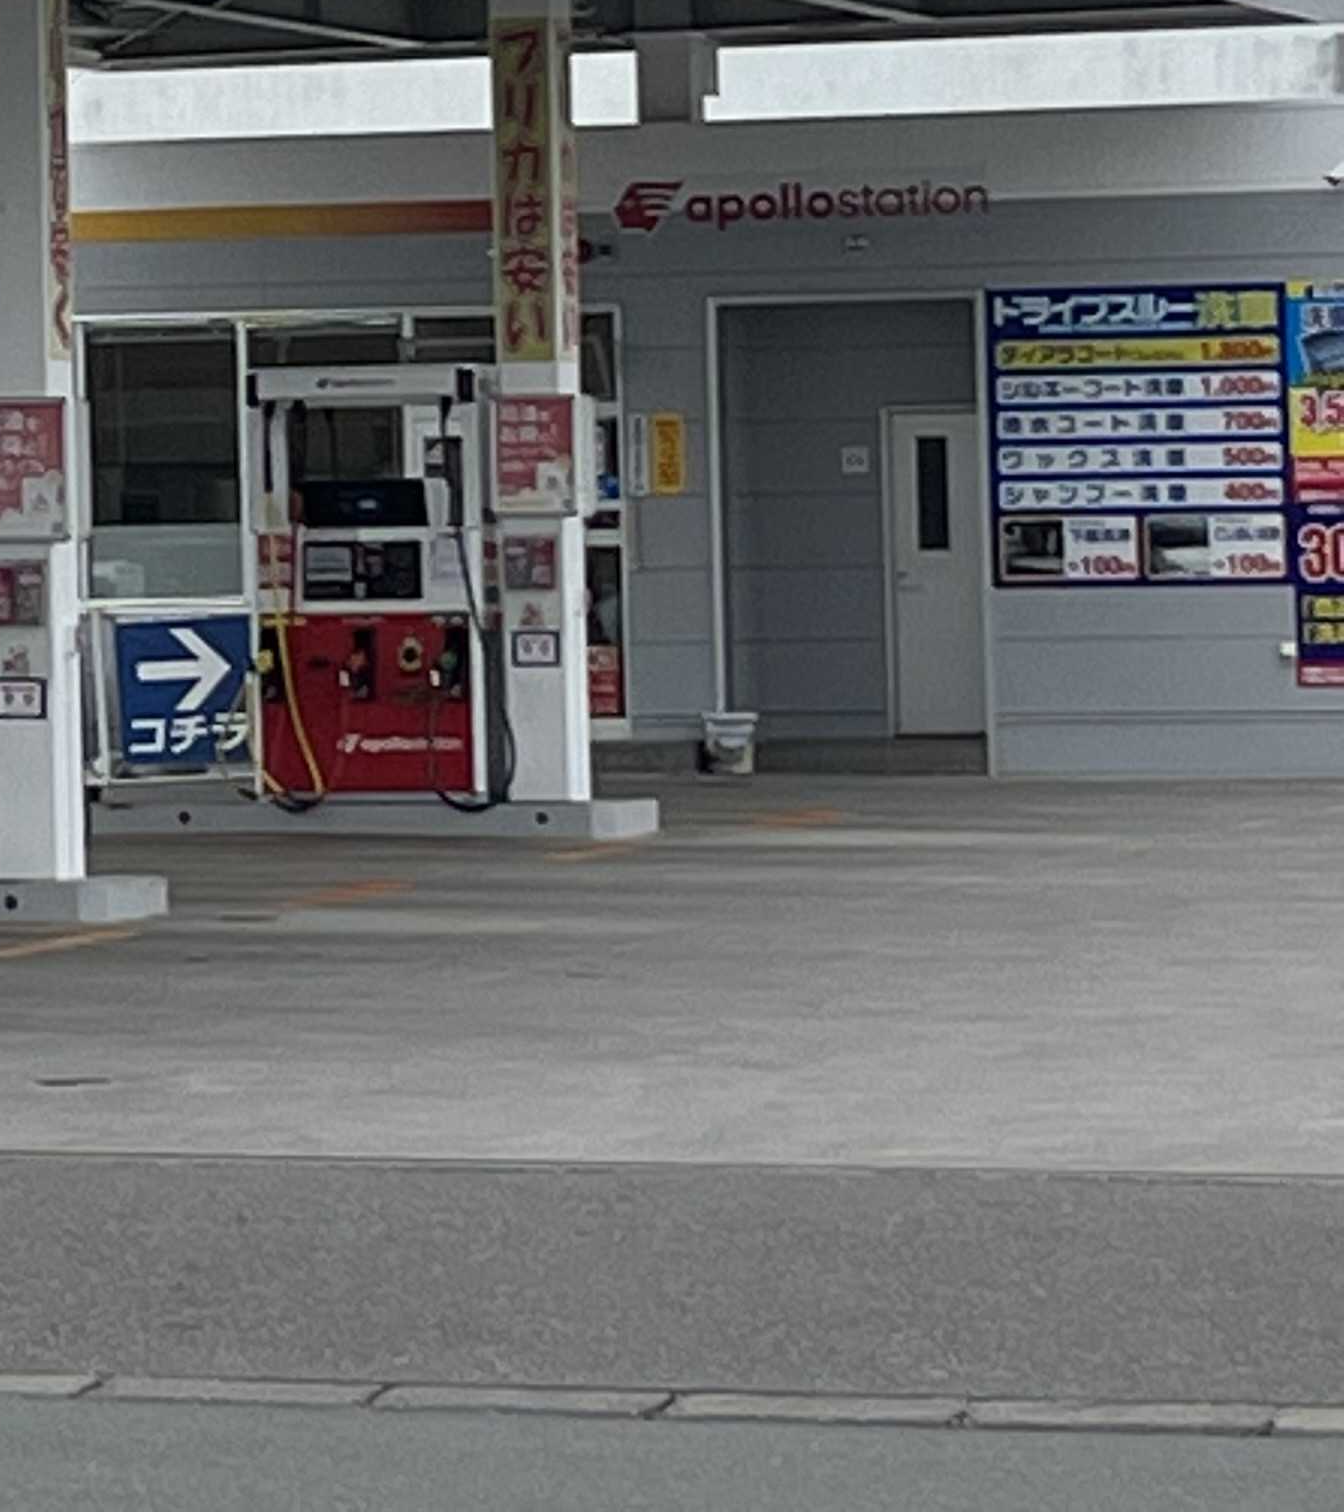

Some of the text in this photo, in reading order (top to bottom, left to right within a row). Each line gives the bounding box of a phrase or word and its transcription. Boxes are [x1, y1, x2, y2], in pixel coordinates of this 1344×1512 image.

[684, 180, 991, 231] apollostation
[128, 712, 249, 755] コチラ
